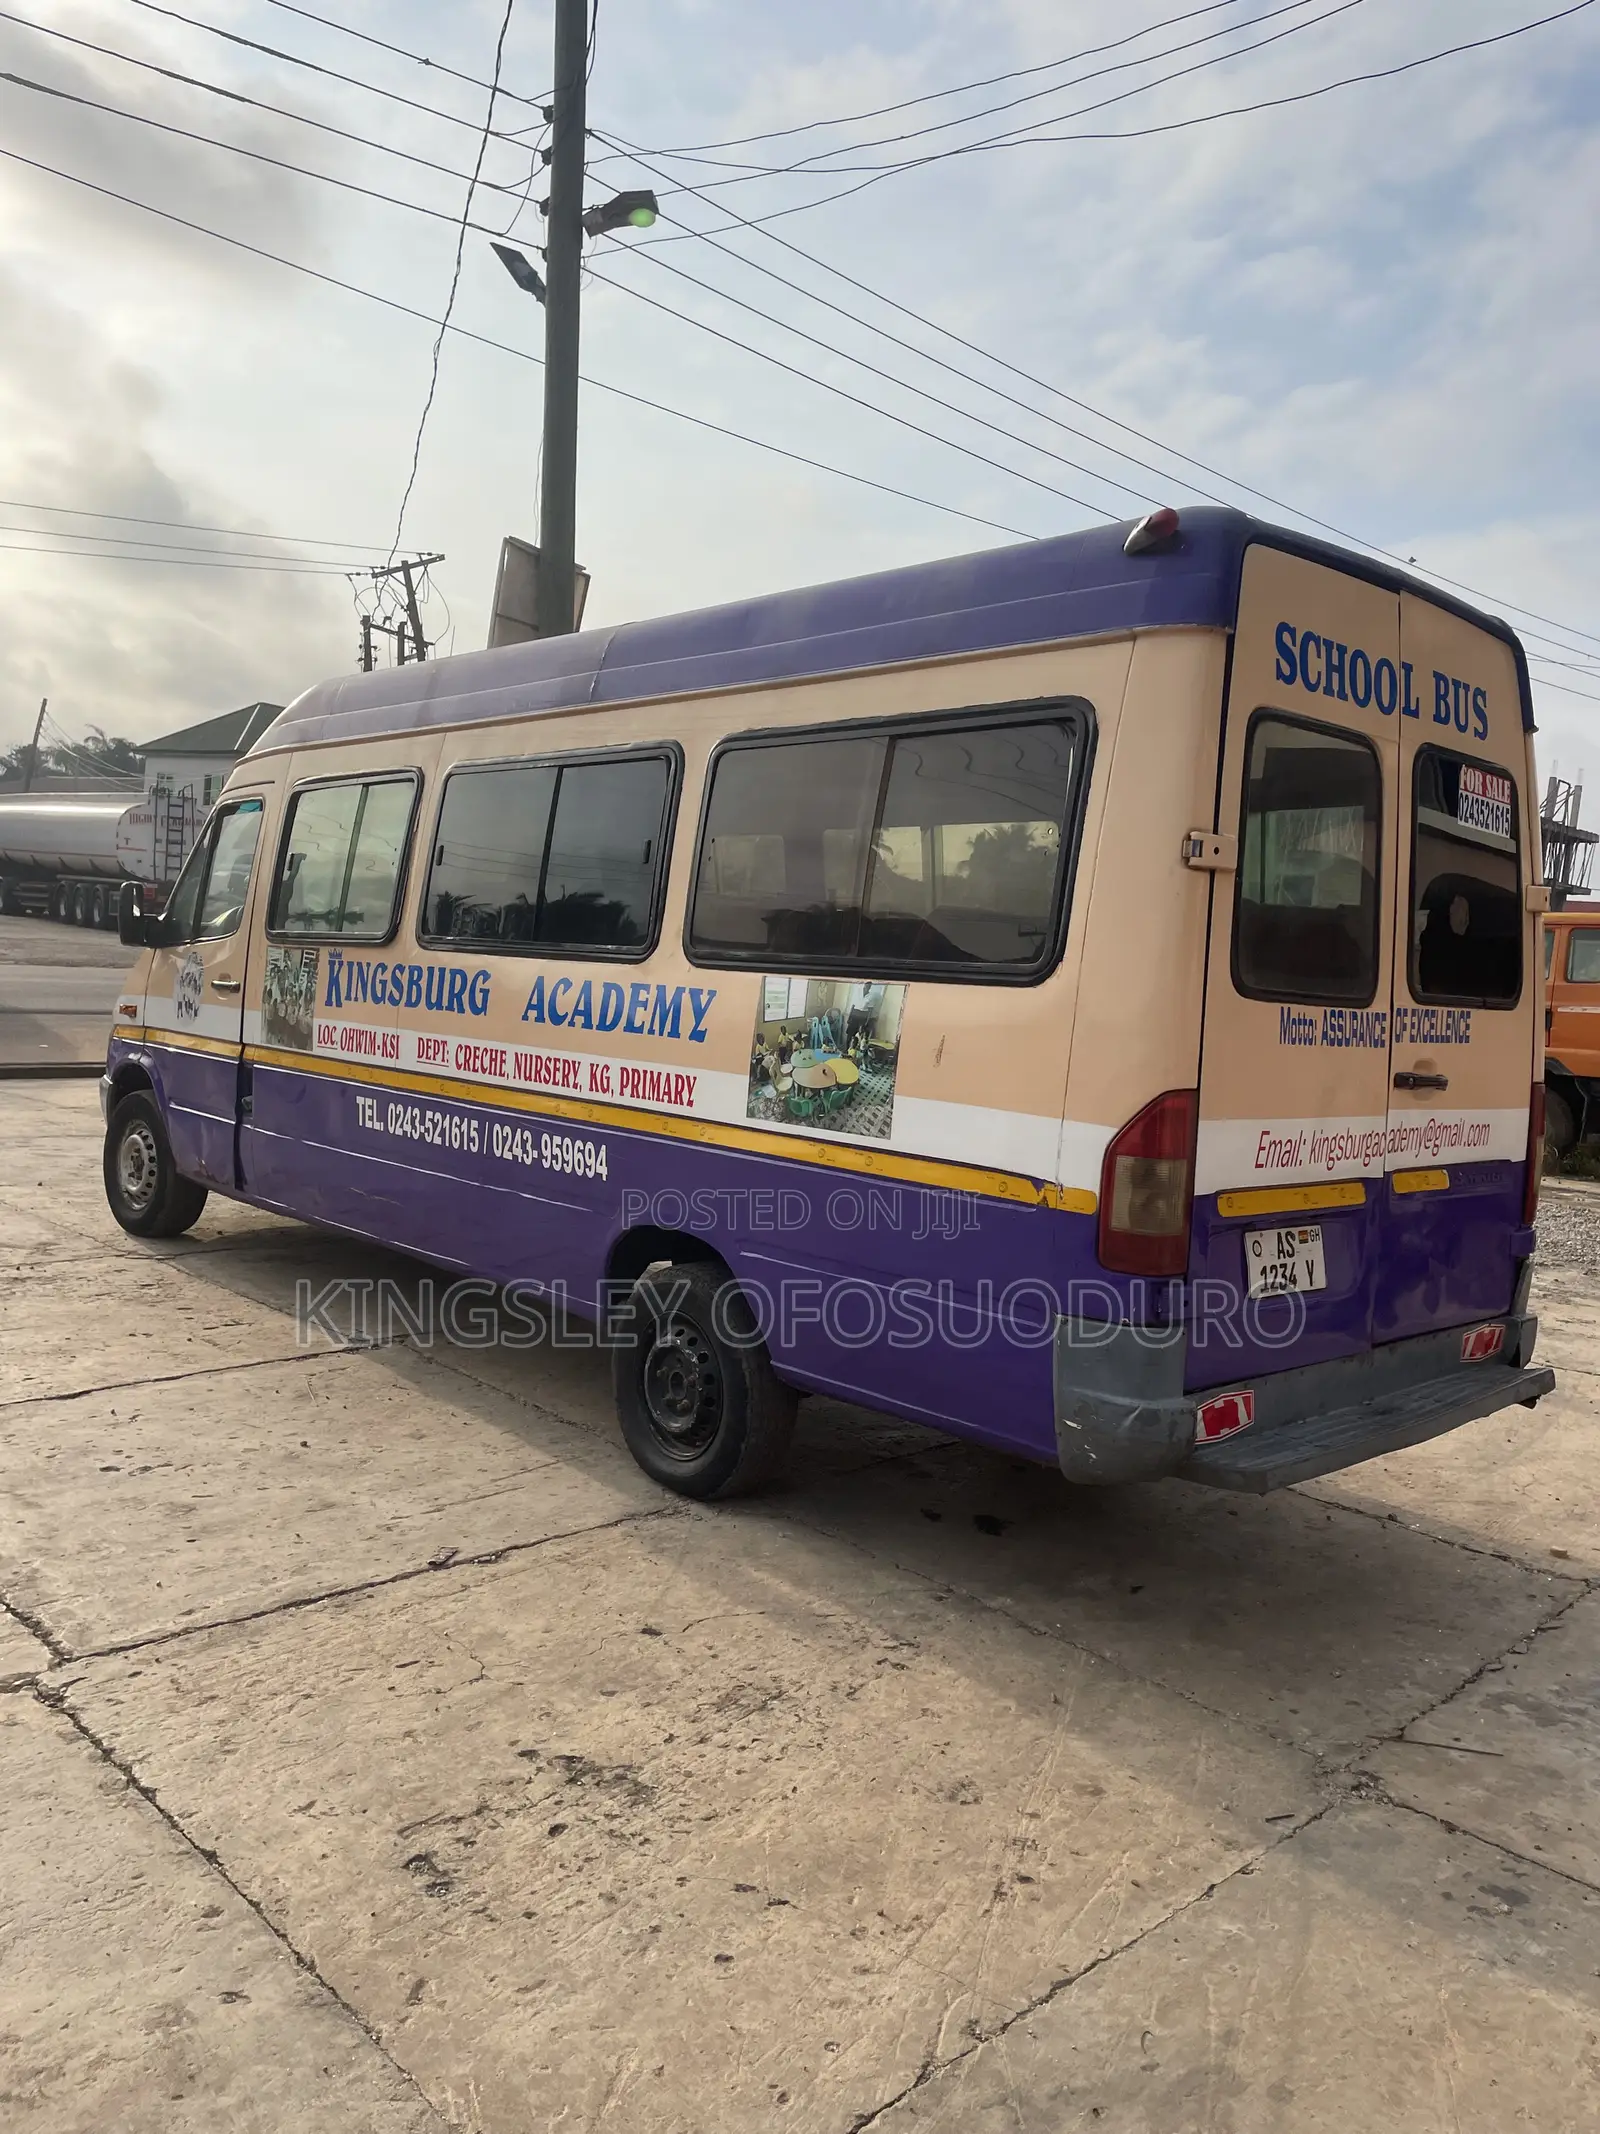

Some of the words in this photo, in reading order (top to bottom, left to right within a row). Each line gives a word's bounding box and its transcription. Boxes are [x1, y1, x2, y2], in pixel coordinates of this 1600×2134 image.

[1275, 621, 1419, 719] SCHOOL
[1433, 670, 1488, 740] BUS
[1460, 766, 1483, 795] FOR
[1485, 774, 1511, 804] SALE
[1459, 793, 1510, 836] 0243521615
[325, 957, 491, 1016] KINGSBURG
[522, 975, 717, 1043] ACADEMY
[317, 1024, 338, 1046] LOC.
[340, 1027, 400, 1060] OHWIM-KSI
[1279, 1006, 1317, 1046] Motto:
[1321, 1009, 1386, 1049] ASSURANCE
[1394, 1008, 1408, 1043] OF
[1409, 1008, 1471, 1044] EXCELLENCE
[417, 1037, 450, 1063] DEPT:
[455, 1044, 509, 1079] CRECHE,
[513, 1051, 582, 1092] NURSERY,
[589, 1063, 614, 1097] KG,
[619, 1067, 697, 1108] PRIMARY
[356, 1096, 384, 1132] TEL.
[387, 1104, 479, 1153] 0243-521615
[1254, 1130, 1307, 1169] Email:
[1308, 1118, 1491, 1171] kingsburgacademy@gmail.com
[1277, 1230, 1296, 1260] AS
[1309, 1228, 1321, 1243] GH
[1260, 1261, 1297, 1293] 1234
[1305, 1259, 1314, 1287] Y
